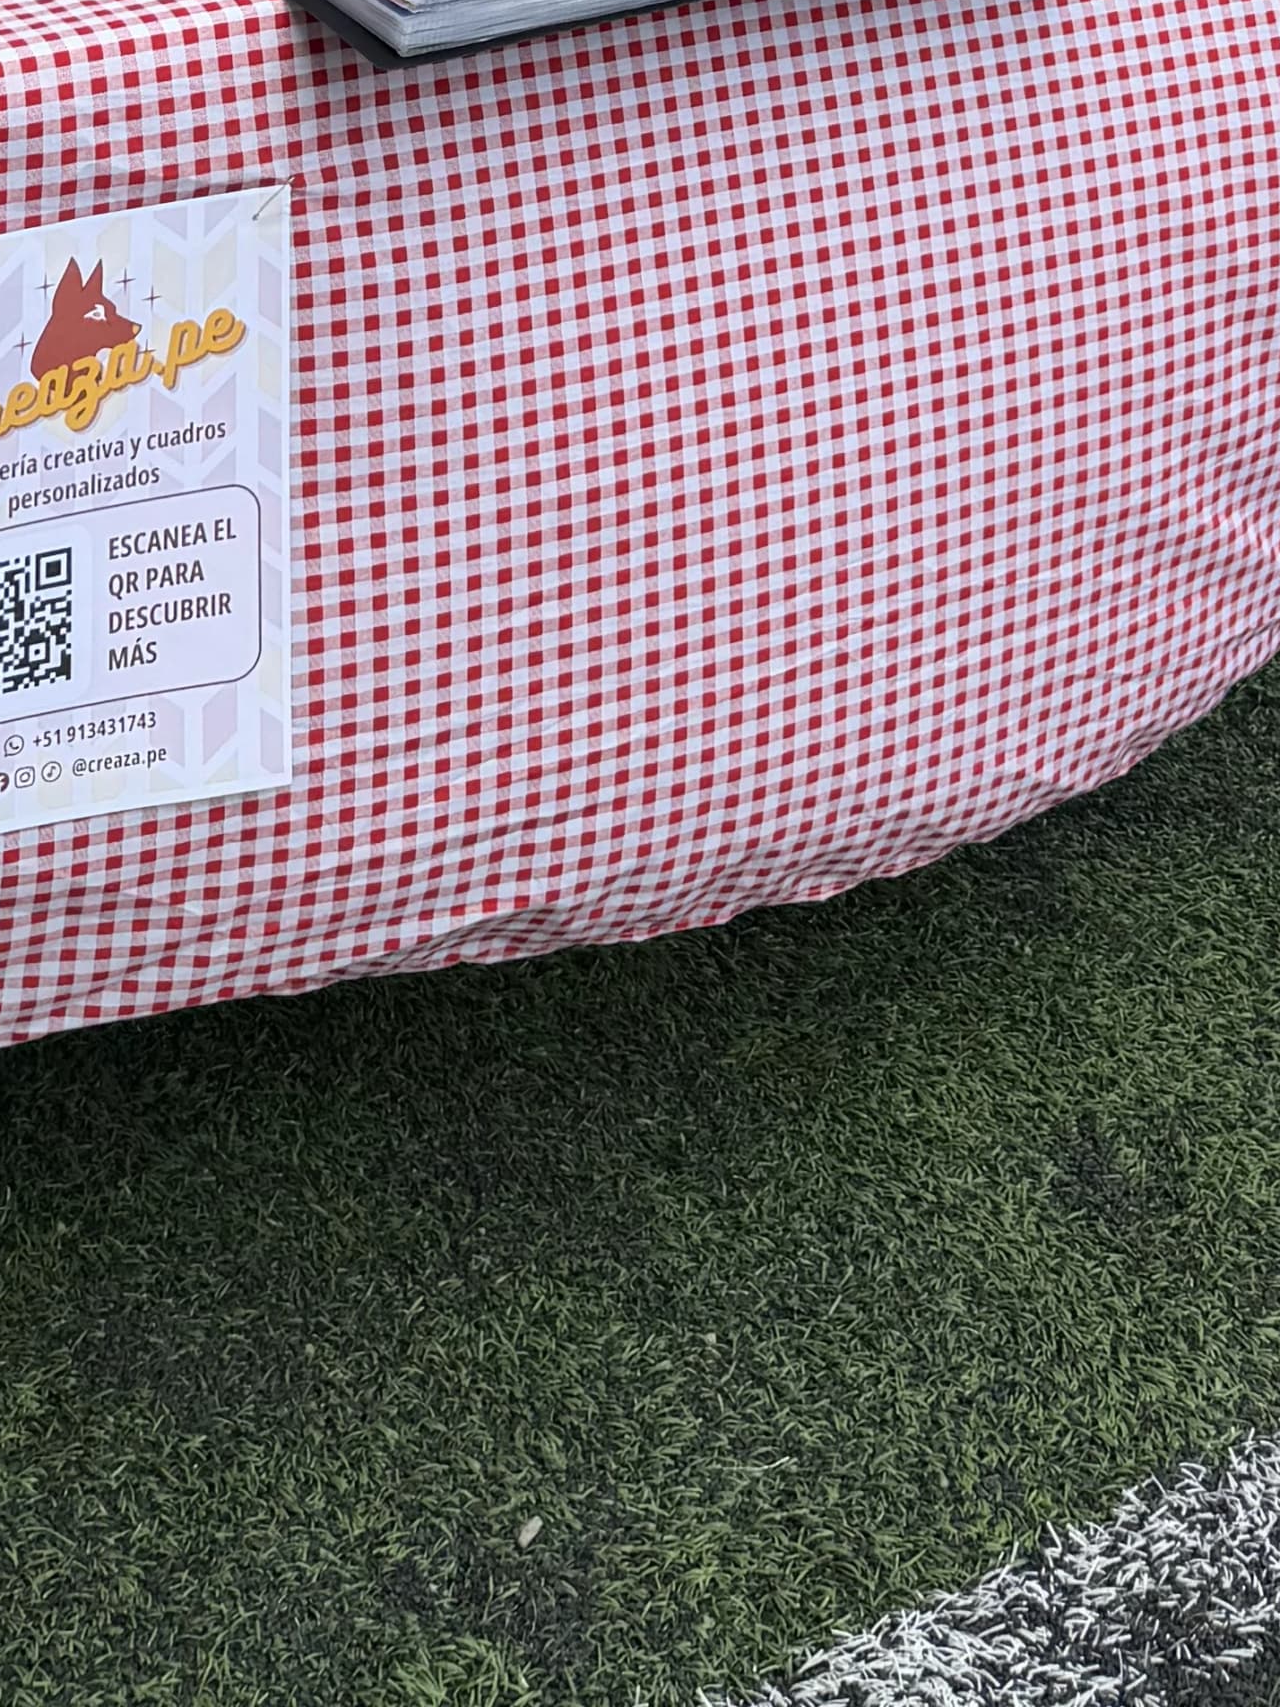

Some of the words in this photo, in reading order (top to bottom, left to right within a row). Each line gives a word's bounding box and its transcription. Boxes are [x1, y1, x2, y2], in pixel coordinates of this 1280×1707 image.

[43, 437, 125, 470] creativa
[130, 436, 142, 460] y
[147, 421, 226, 451] cuadros
[8, 465, 160, 517] personalizados
[109, 522, 207, 560] ESCANEA
[214, 517, 237, 542] EL
[108, 571, 139, 600] QR
[146, 560, 205, 590] PARA
[109, 593, 232, 634] DESCUBRIR
[108, 637, 157, 671] MÁS
[32, 729, 61, 747] +51
[67, 712, 157, 742] 913431743
[72, 748, 167, 777] @creaza.pe
